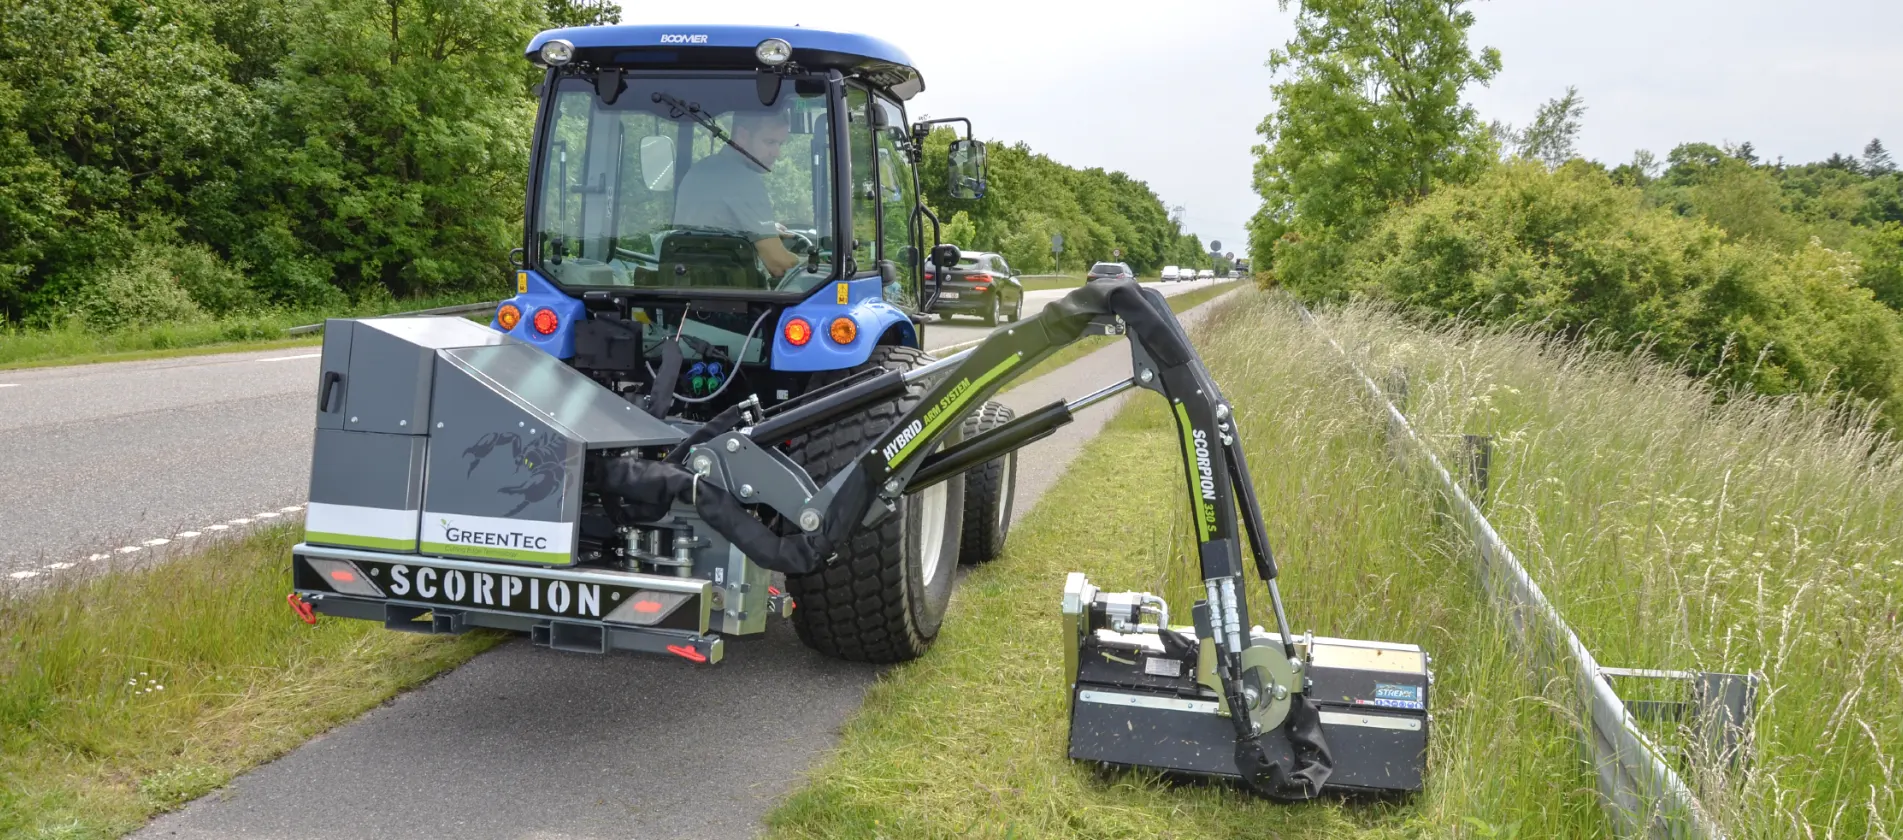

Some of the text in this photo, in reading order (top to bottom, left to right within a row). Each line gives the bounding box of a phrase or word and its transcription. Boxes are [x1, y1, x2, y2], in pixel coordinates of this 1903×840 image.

[661, 34, 708, 43] BOOMER
[883, 377, 971, 461] HYBRID ARM SYSTEM
[1193, 429, 1216, 500] SCORPION
[1204, 503, 1216, 523] 330
[390, 565, 600, 617] SCORPION
